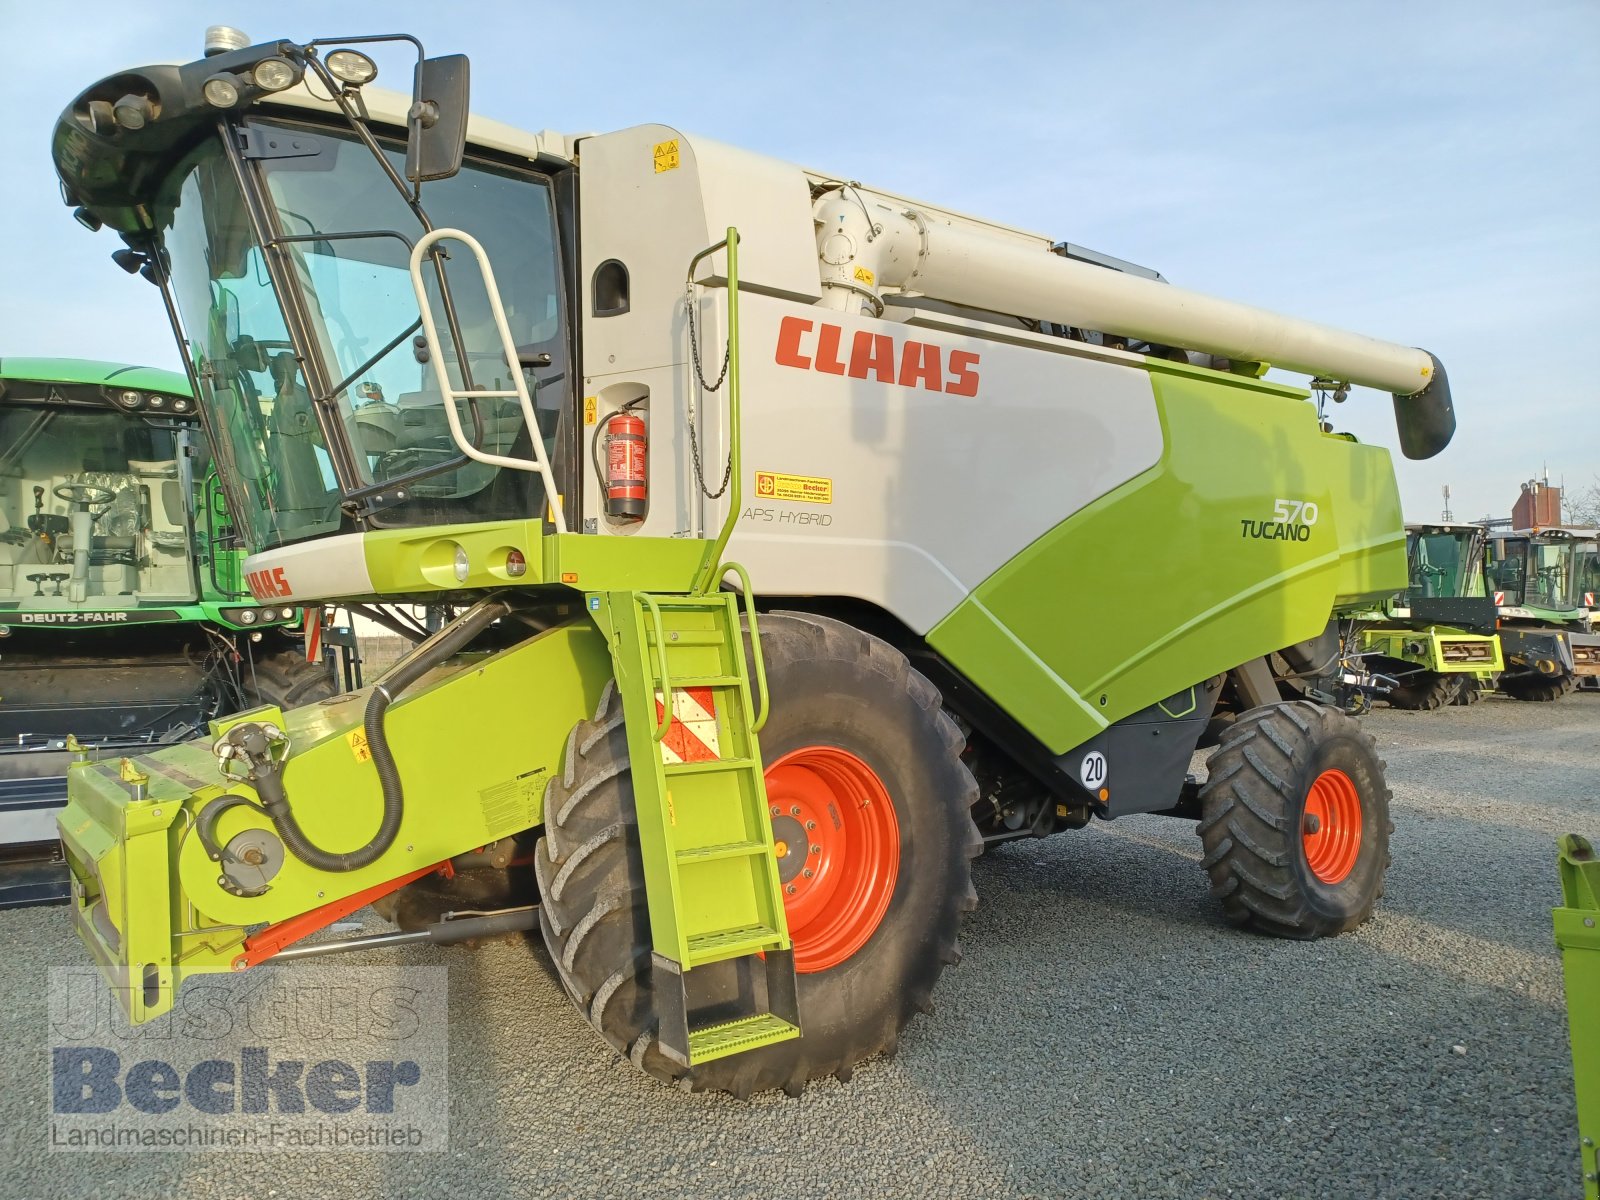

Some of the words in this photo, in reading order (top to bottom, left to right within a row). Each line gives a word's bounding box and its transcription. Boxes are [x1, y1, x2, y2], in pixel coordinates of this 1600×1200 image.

[775, 316, 980, 397] CLAAS
[803, 484, 828, 492] Becker
[742, 507, 774, 521] APS
[779, 510, 833, 526] HYBRID
[1273, 499, 1318, 526] 570
[1241, 519, 1311, 542] TUCANO
[21, 612, 128, 623] DEUTZ-FAHR
[1086, 756, 1103, 782] 20
